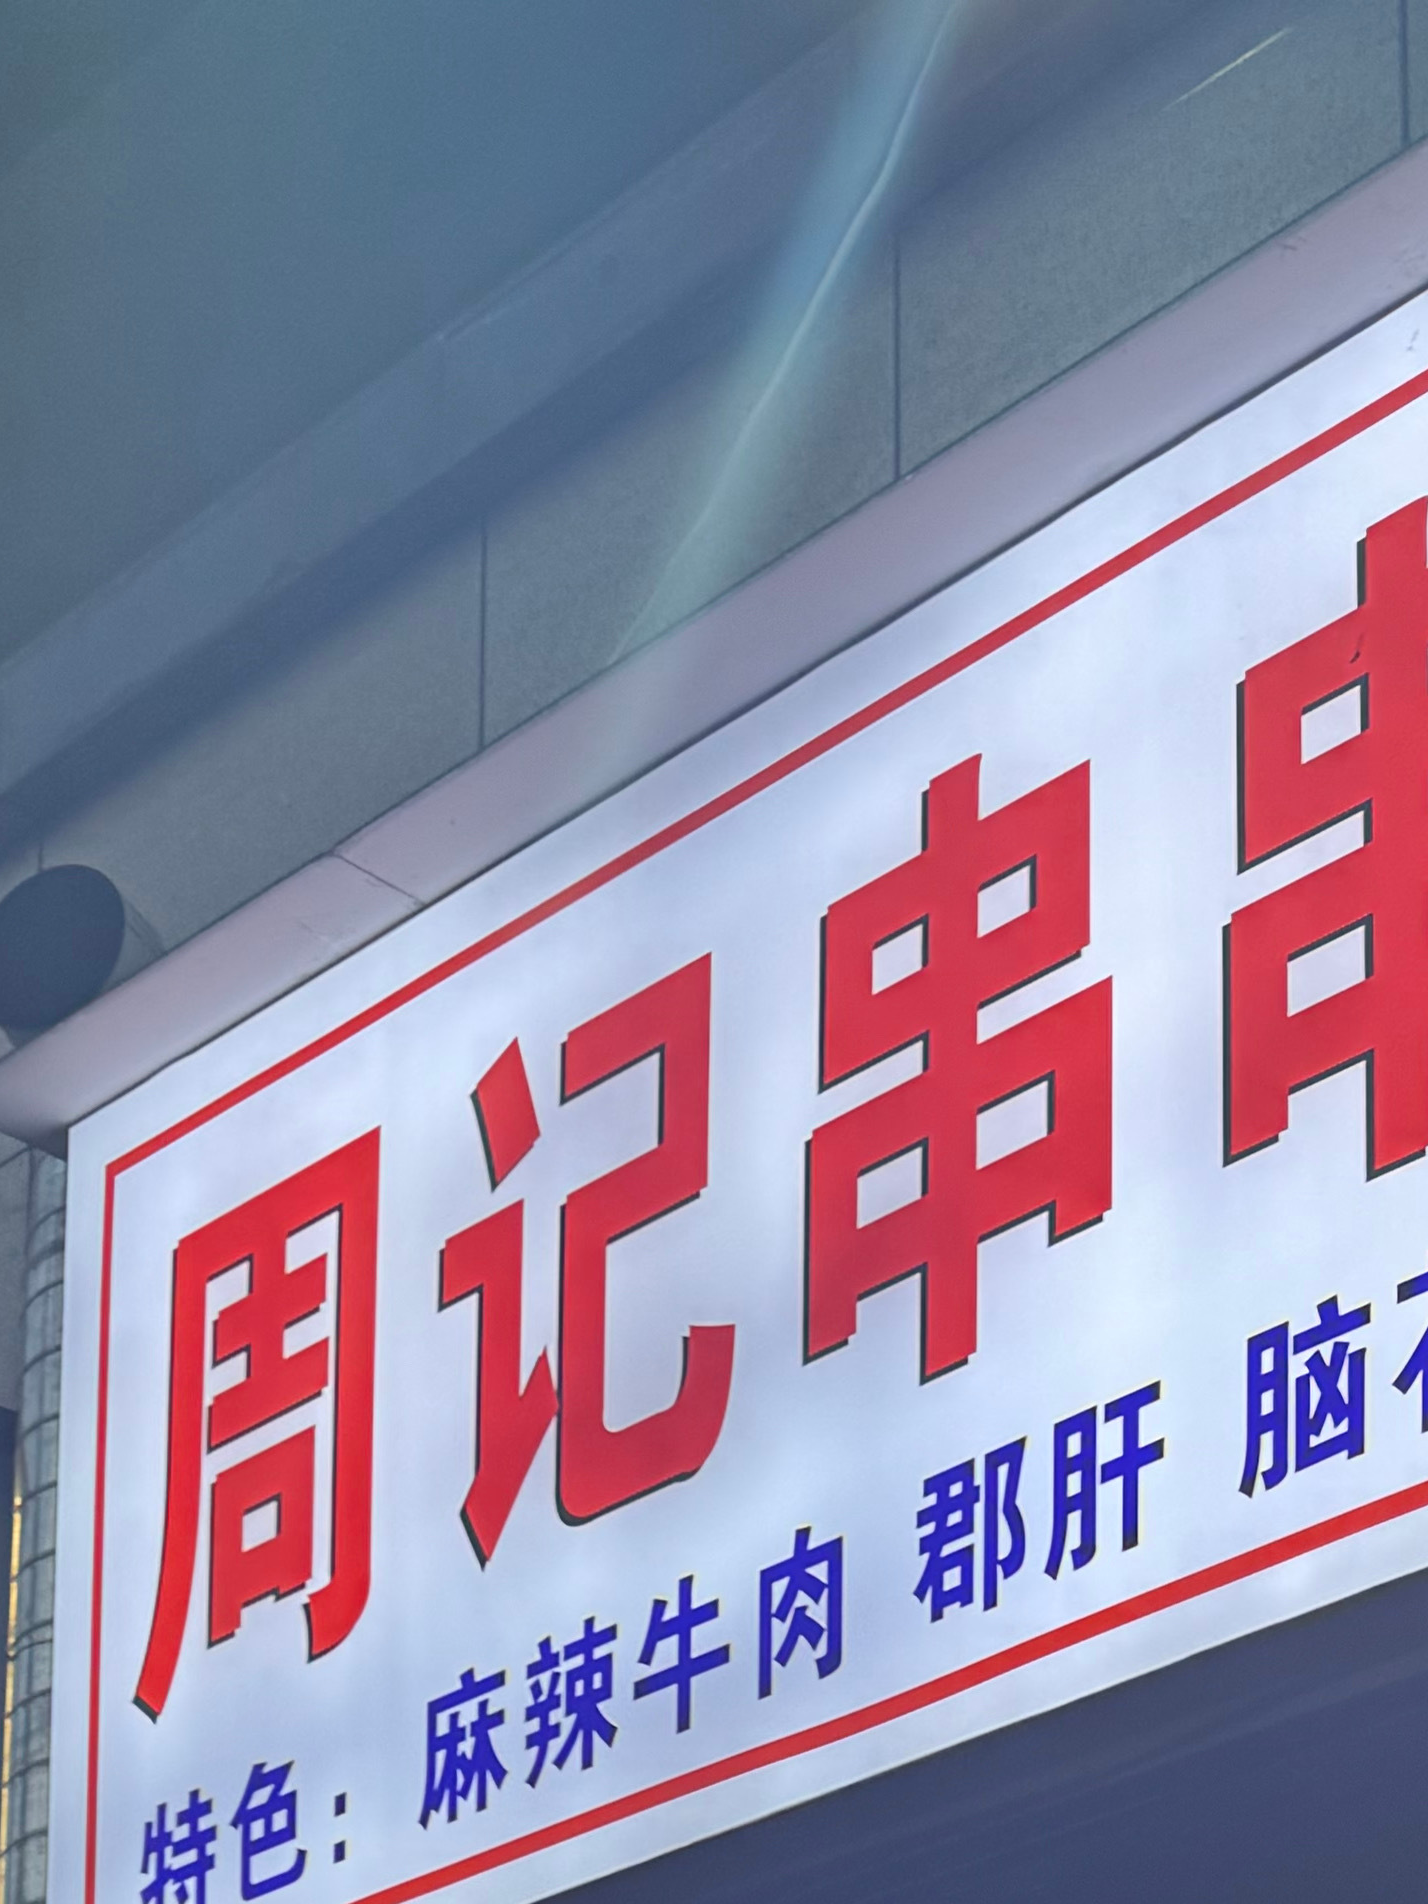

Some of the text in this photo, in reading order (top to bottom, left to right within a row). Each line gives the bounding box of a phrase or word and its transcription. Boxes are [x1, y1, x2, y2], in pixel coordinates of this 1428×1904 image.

[420, 1531, 843, 1826] 麻辣牛肉
[912, 1385, 1162, 1622] 郡肝
